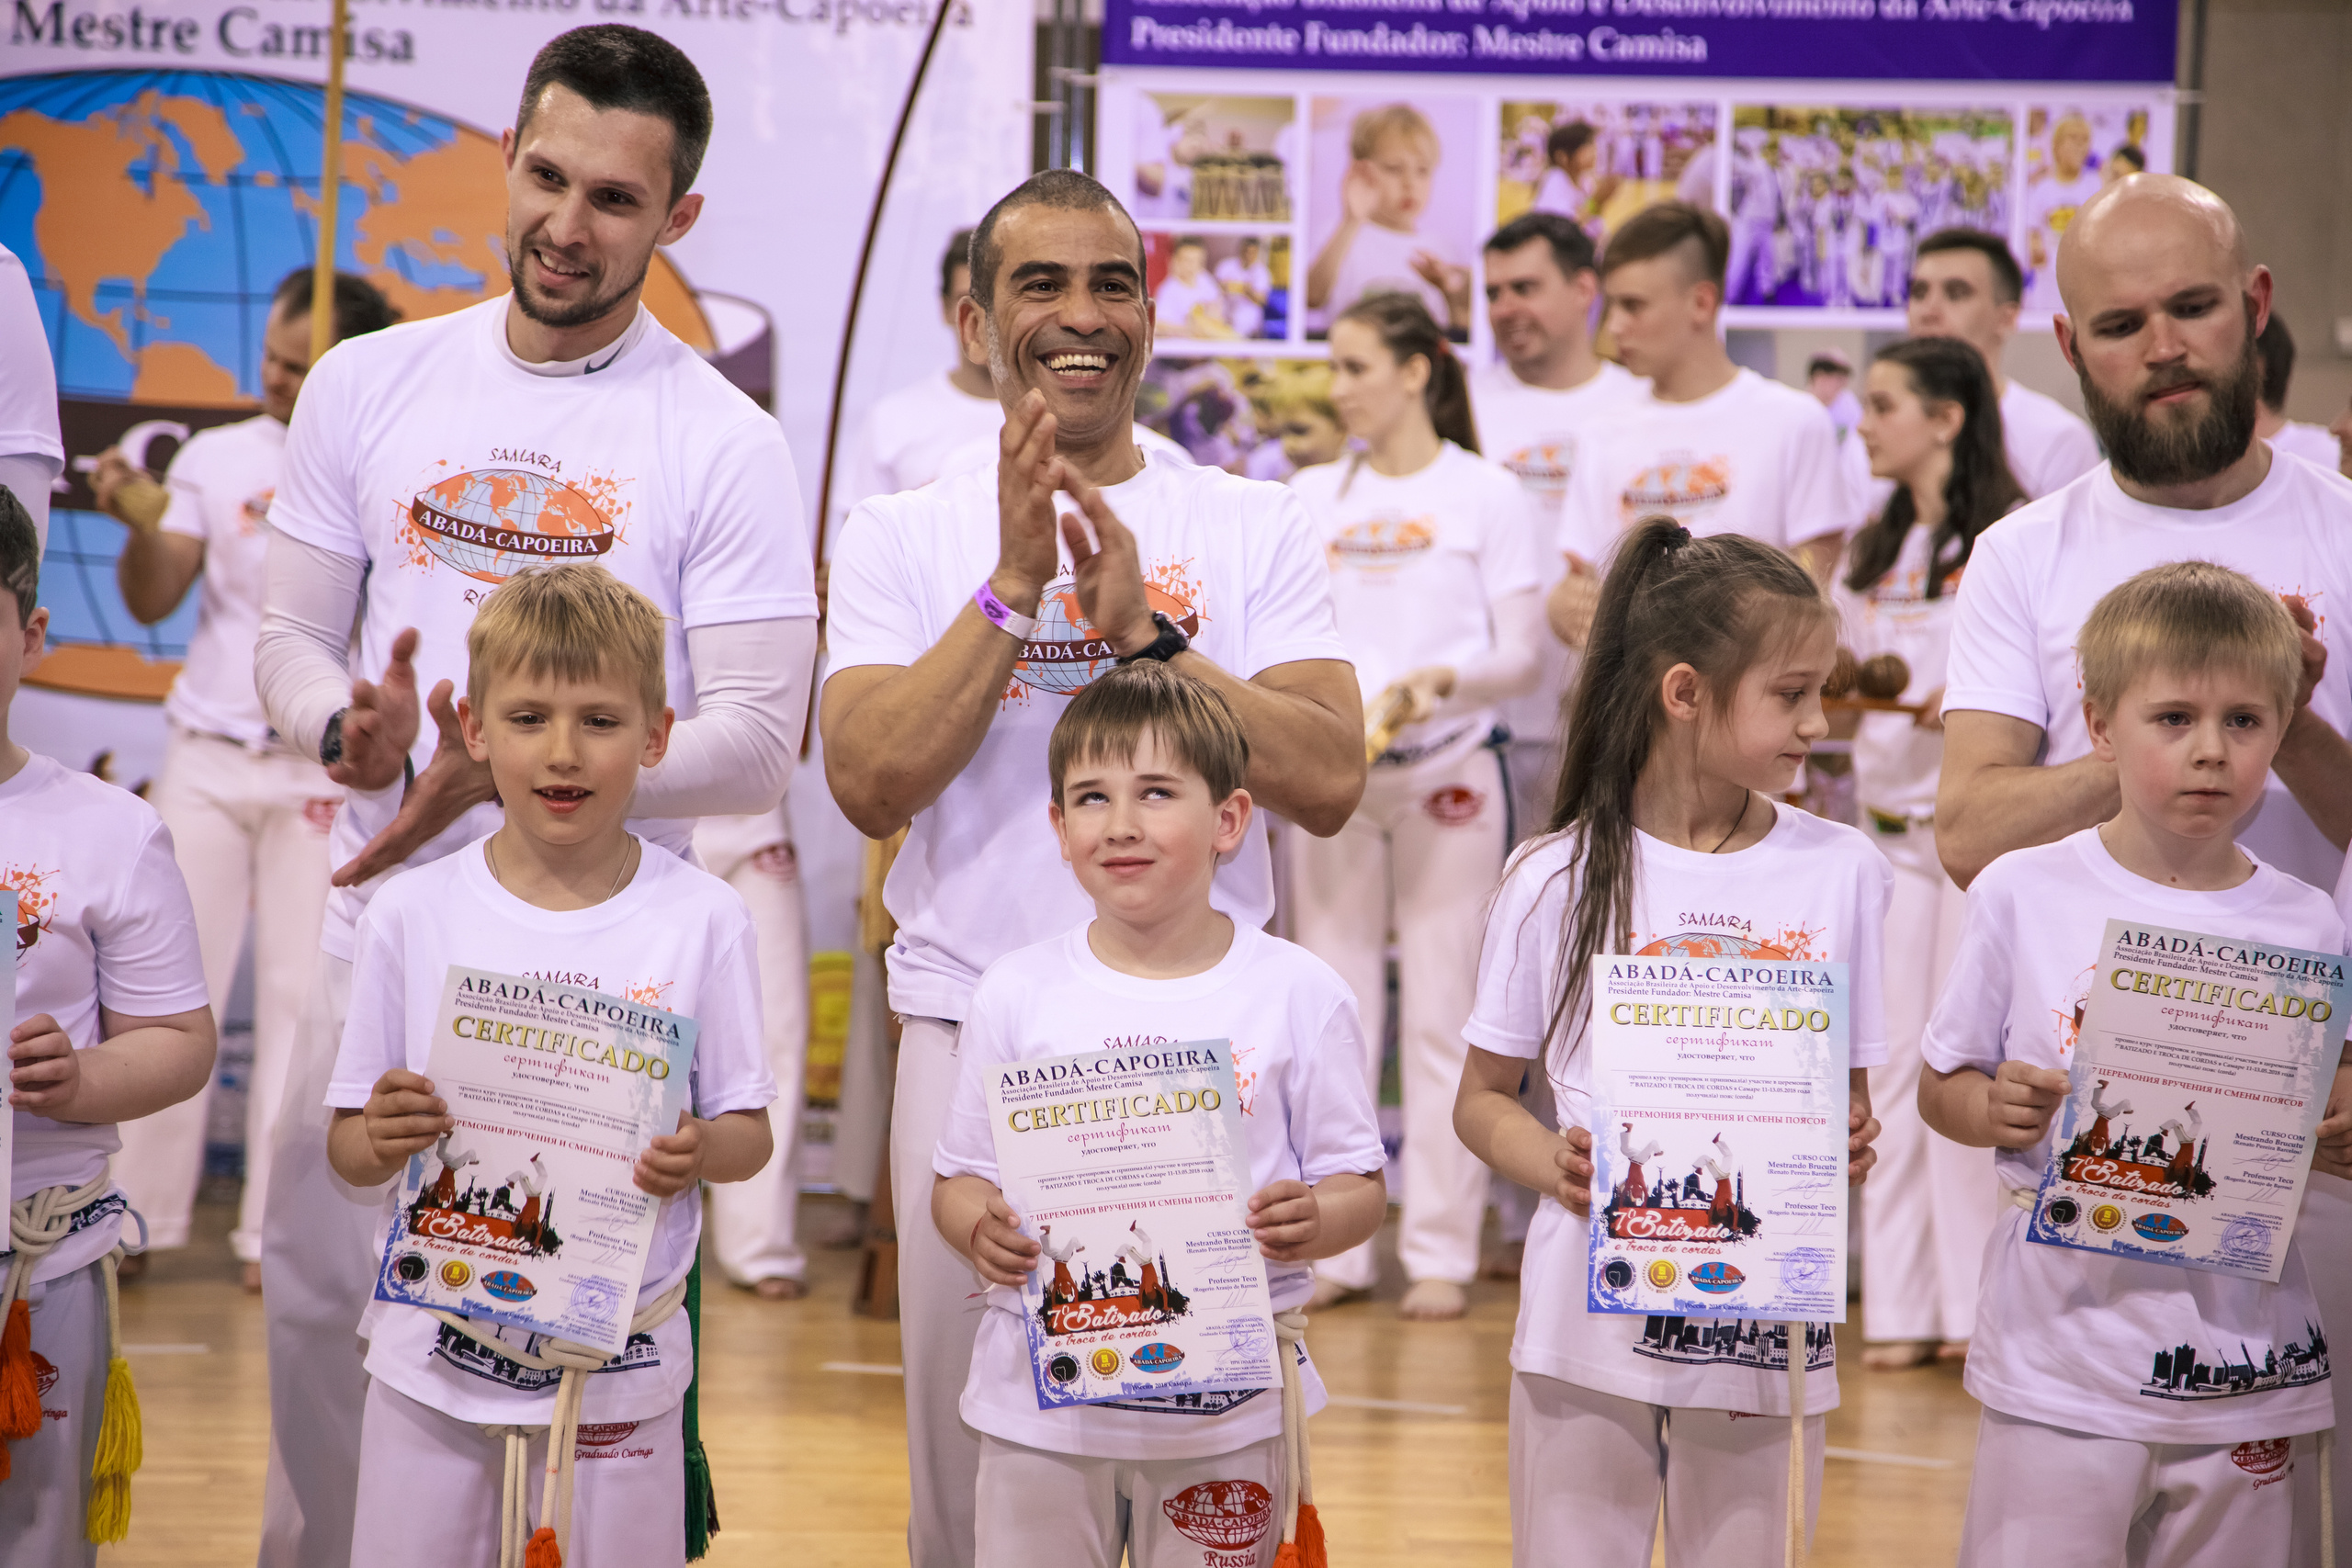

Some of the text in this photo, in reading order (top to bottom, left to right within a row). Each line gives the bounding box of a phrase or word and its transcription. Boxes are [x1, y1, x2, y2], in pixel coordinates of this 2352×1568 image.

[11, 0, 199, 54] Mestre
[1130, 16, 1301, 54] Presidente
[1472, 24, 1585, 61] Mestre
[1588, 26, 1707, 62] Camisa
[489, 447, 562, 473] SAMARA
[418, 510, 598, 553] ABADÁ-CAPOEIRA
[1679, 912, 1753, 932] SAMARA
[2113, 952, 2258, 982] Presidente Fundador: Mestre Camisa
[2117, 930, 2345, 980] ABADÁ-CAPOEIRA
[1608, 962, 1833, 985] ABADÁ-CAPOEIRA
[2154, 951, 2186, 961] Brasileira
[2197, 958, 2218, 967] Apoio
[2224, 963, 2285, 977] Desenvolvimento
[2295, 975, 2344, 987] Arte-Capoeira
[1608, 987, 1751, 998] Presidente Fundador: Mestre Camisa
[1716, 983, 1775, 991] Desenvolvimento
[1787, 986, 1834, 994] Arte-Capoeira
[2108, 966, 2334, 1023] CERTIFICADO
[458, 976, 681, 1040] ABADÁ-CAPOEIRA
[1610, 1001, 1829, 1032] CERTIFICADO
[2160, 1007, 2268, 1031] сертификат
[450, 1013, 672, 1082] CERTIFICADO
[1666, 1032, 1773, 1051] сертификат
[503, 1055, 610, 1083] сертификат
[1000, 1049, 1218, 1088] ABADÁ-CAPOEIRA
[1037, 1079, 1069, 1089] Brasileira
[1080, 1076, 1101, 1085] Apoio
[1107, 1069, 1164, 1081] Desenvolvimento
[1174, 1064, 1220, 1075] Arte-Capoeira
[1001, 1078, 1142, 1103] Presidente Fundador: Mestre Camisa
[2098, 1067, 2160, 1085] ЦЕРЕМОНИЯ
[2161, 1078, 2212, 1092] ВРУЧЕНИЯ
[2223, 1089, 2260, 1100] СМЕНЫ
[2262, 1095, 2303, 1107] ПОЯСОВ
[1006, 1087, 1222, 1134] CERTIFICADO
[1621, 1110, 1681, 1120] ЦЕРЕМОНИЯ
[1684, 1112, 1734, 1121] ВРУЧЕНИЯ
[1747, 1114, 1782, 1122] СМЕНЫ
[1785, 1116, 1826, 1124] ПОЯСОВ
[1067, 1122, 1171, 1146] сертификат
[2233, 1132, 2303, 1150] Mestrando Brucutu
[2260, 1129, 2305, 1142] CURSO COM
[2243, 1170, 2277, 1181] Professor
[1035, 1206, 1096, 1221] ЦЕРЕМОНИЯ
[1098, 1201, 1147, 1213] ВРУЧЕНИЯ
[1158, 1197, 1192, 1206] СМЕНЫ
[1193, 1193, 1233, 1203] ПОЯСОВ
[1208, 1276, 1239, 1284] Professor
[574, 1449, 619, 1461] Graduado
[2253, 1471, 2286, 1490] Graduado
[1204, 1549, 1257, 1568] Russia
